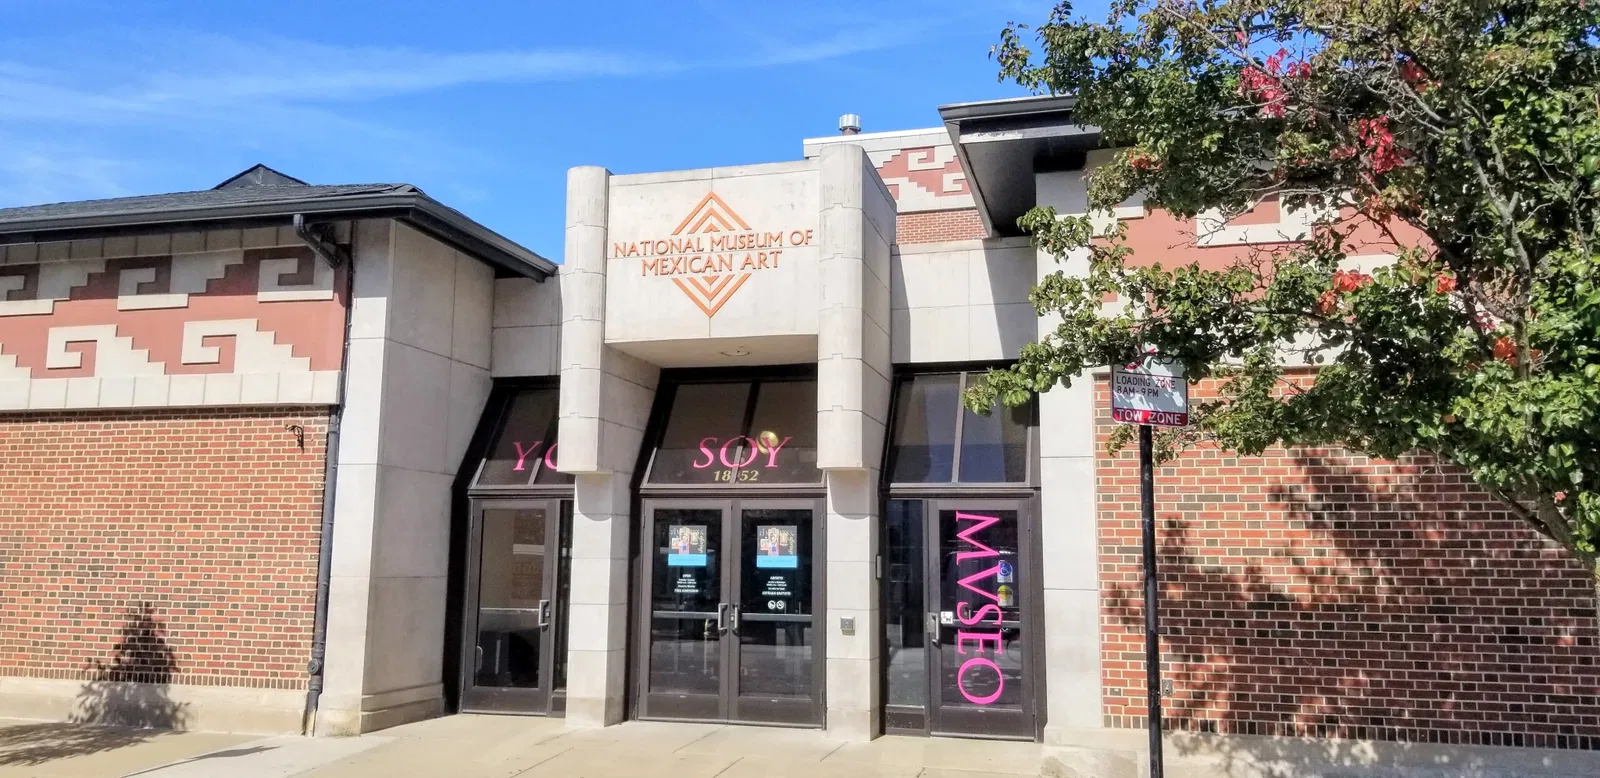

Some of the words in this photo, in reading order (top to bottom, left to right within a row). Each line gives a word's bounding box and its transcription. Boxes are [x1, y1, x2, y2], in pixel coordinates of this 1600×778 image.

[613, 236, 704, 258] NATIONAL
[709, 230, 783, 251] MUSEUM
[789, 229, 813, 246] OF
[641, 253, 733, 277] MEXICAN
[739, 250, 783, 270] ART
[1116, 375, 1151, 387] LOADING
[1155, 378, 1176, 390] ZONE
[1117, 409, 1143, 421] TOW
[1148, 411, 1182, 425] ZONE
[692, 435, 792, 469] SOY
[955, 510, 1004, 704] MVSEO
